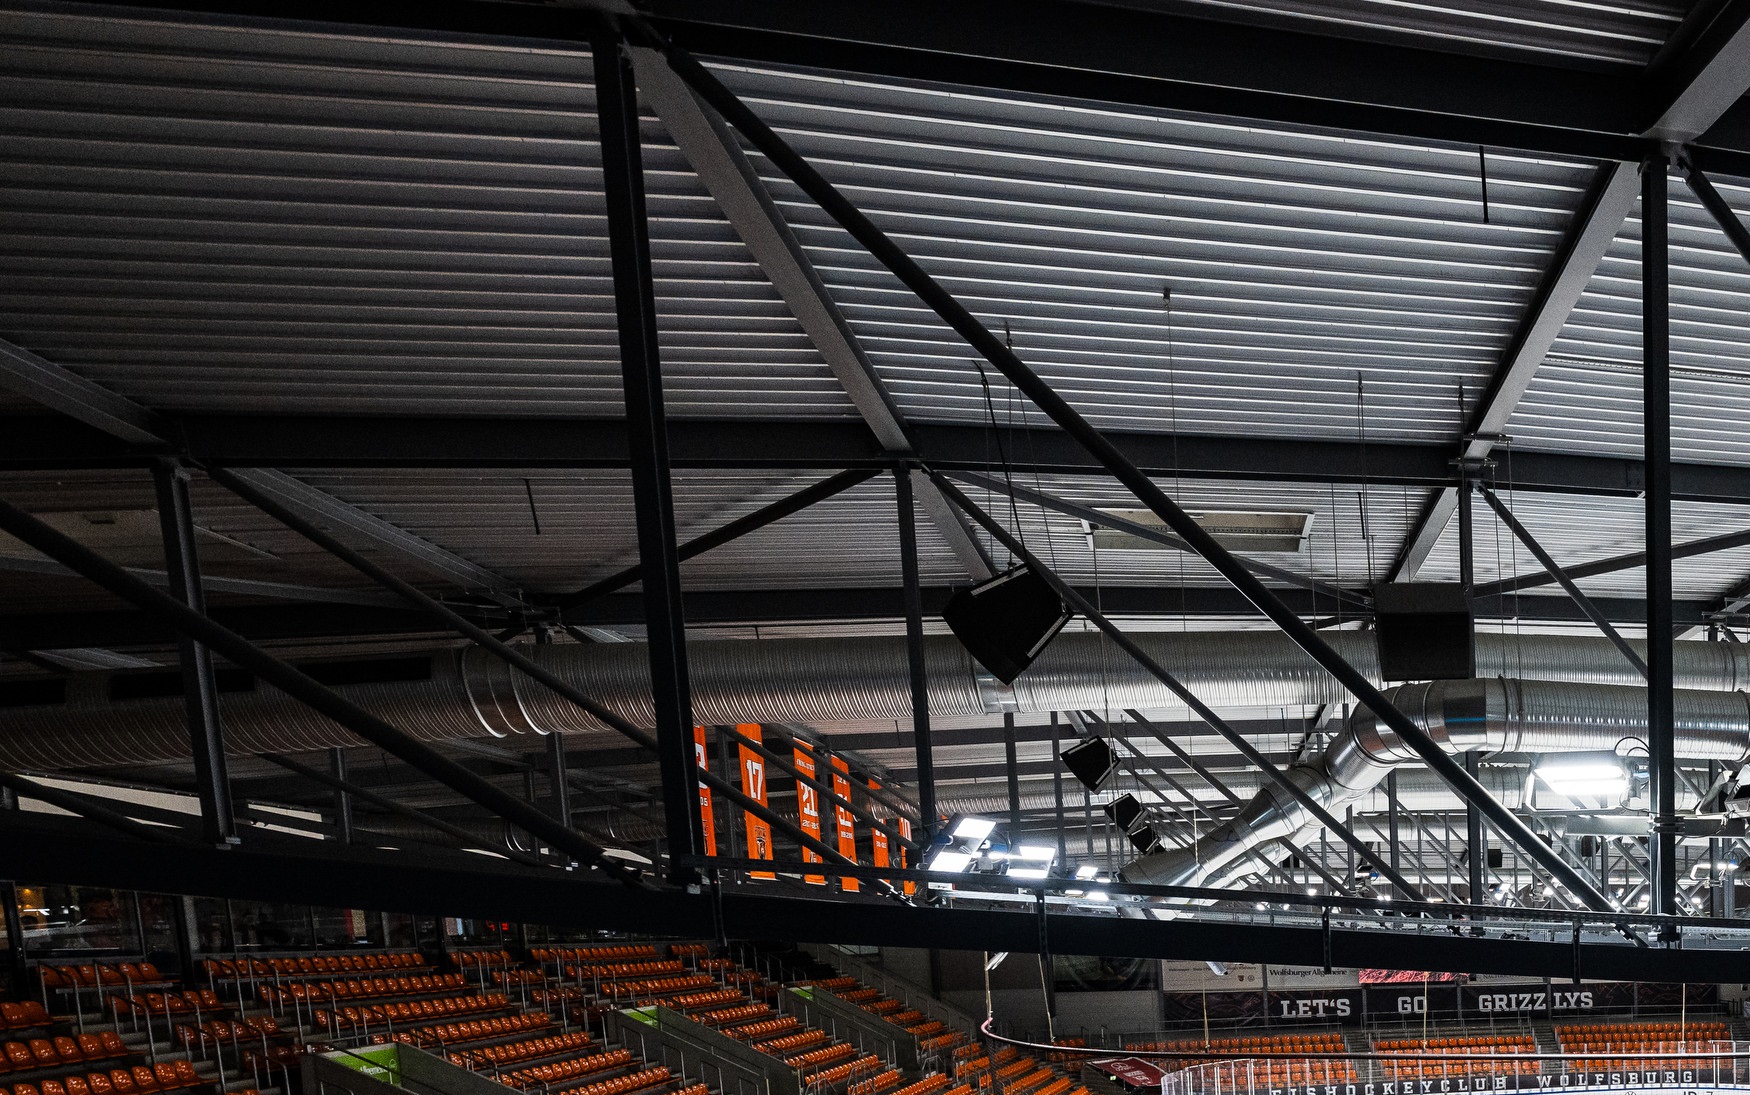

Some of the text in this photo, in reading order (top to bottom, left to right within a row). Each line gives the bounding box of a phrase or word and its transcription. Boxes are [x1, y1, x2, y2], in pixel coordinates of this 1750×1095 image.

[746, 759, 763, 801] 17
[1269, 968, 1311, 978] Wolfsburger
[1397, 996, 1427, 1014] GO
[1536, 1070, 1693, 1088] WOLFSBURG
